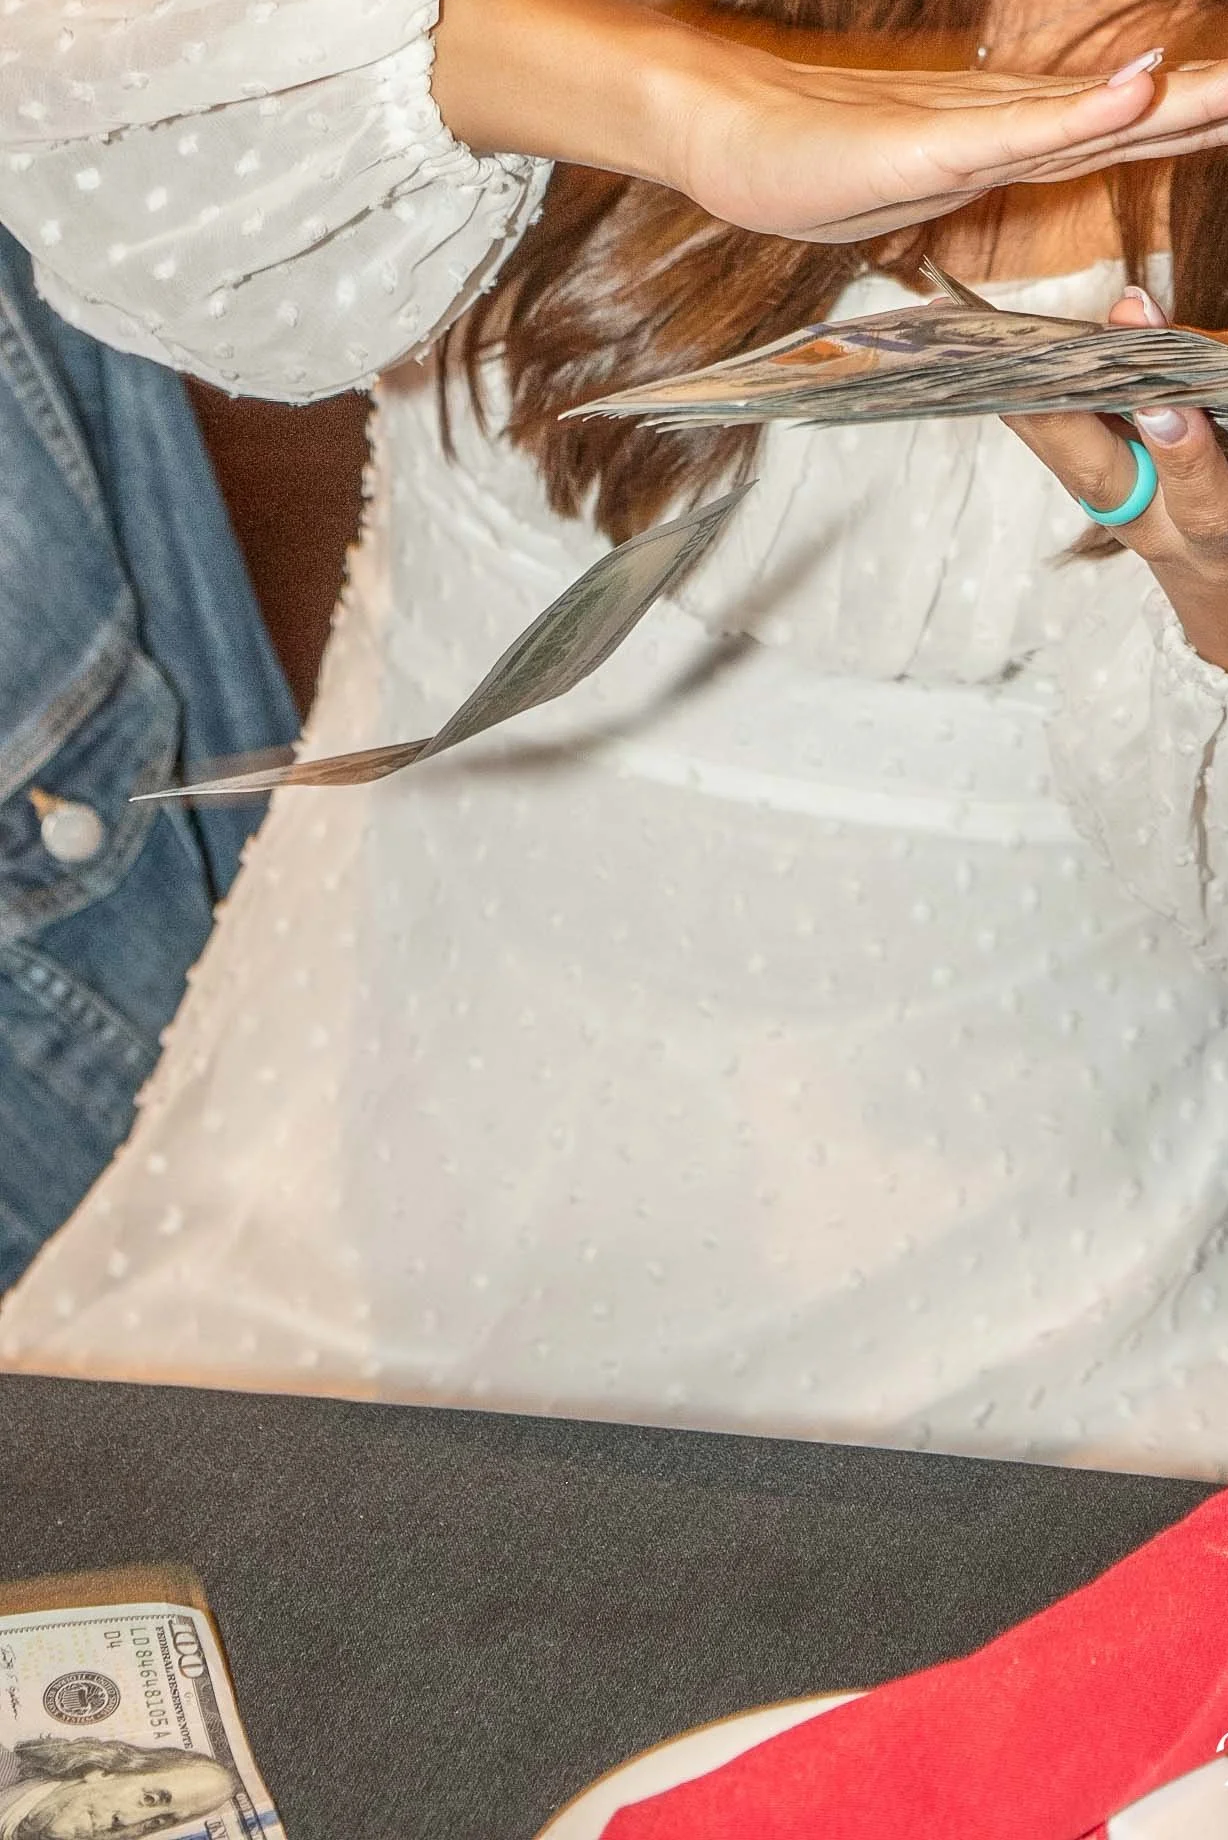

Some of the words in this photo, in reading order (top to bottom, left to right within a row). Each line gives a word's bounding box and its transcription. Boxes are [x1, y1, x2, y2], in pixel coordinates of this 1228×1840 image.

[103, 1630, 123, 1649] D4
[167, 1618, 205, 1680] 100
[155, 1626, 173, 1673] FEDERAL
[178, 1722, 193, 1749] NOTE
